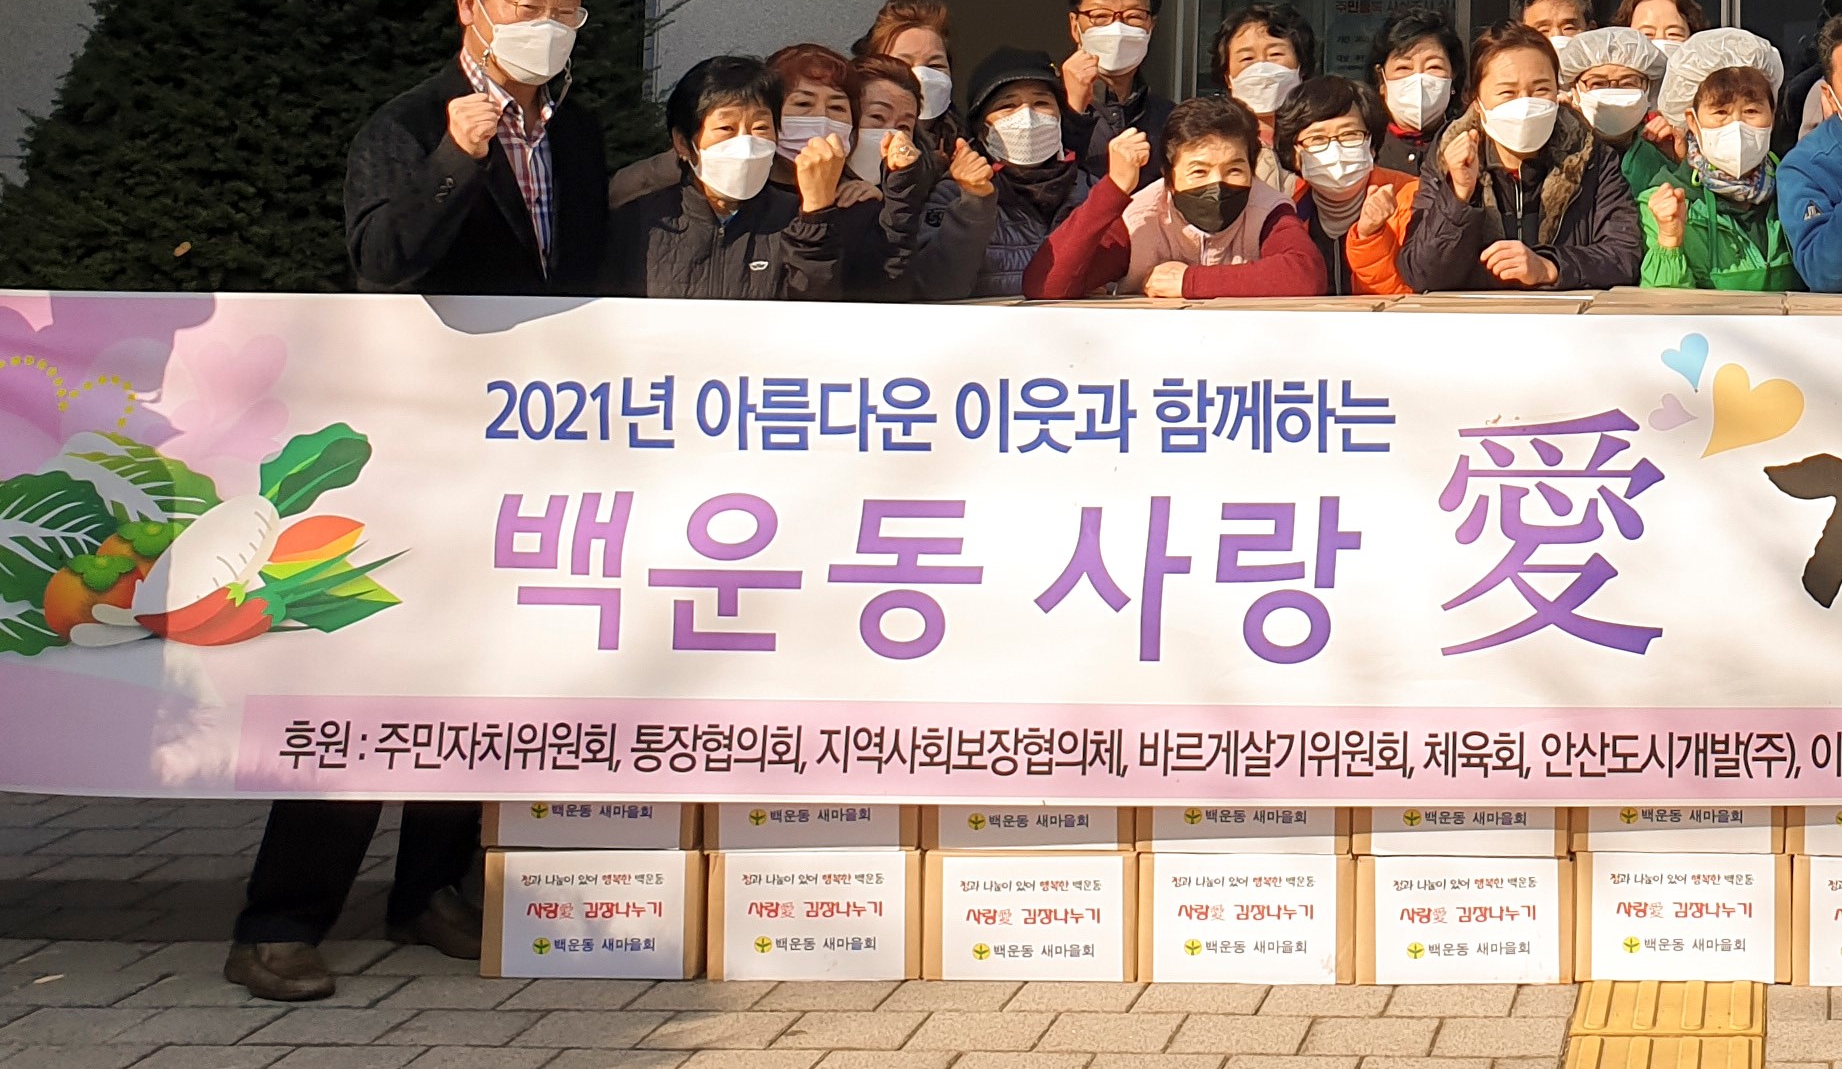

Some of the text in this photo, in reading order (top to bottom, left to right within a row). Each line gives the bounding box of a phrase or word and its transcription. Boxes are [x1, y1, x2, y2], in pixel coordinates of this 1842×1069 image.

[485, 375, 1396, 453] 2021년 아름다운 이웃과 함께하는
[494, 491, 983, 660] 백운동
[1034, 496, 1362, 664] 사랑
[1439, 407, 1665, 656] 愛
[280, 721, 350, 769] 후원
[550, 802, 654, 818] 백운동 새마을회
[770, 806, 872, 822] 백운동 새마을회
[1206, 807, 1306, 824] 백운동 새마을회
[1640, 807, 1744, 823] 백운동 새마을회
[989, 814, 1088, 828] 백운동 새마을회
[1425, 809, 1528, 828] 백운동 새마을회
[584, 902, 662, 921] 김장나누기
[804, 902, 882, 917] 김장나누기
[1022, 909, 1100, 924] 김장나누기
[1234, 905, 1313, 920] 김장나누기
[1456, 905, 1536, 922] 김장나누기
[1673, 902, 1752, 918] 김장나누기
[554, 938, 655, 952] 백운동 새마을회
[776, 937, 875, 950] 백운동 새마을회
[994, 944, 1094, 958] 백운동 새마을회
[1206, 941, 1306, 954] 백운동 새마을회
[1429, 942, 1530, 956] 백운동 새마을회
[1645, 938, 1745, 951] 백운동 새마을회
